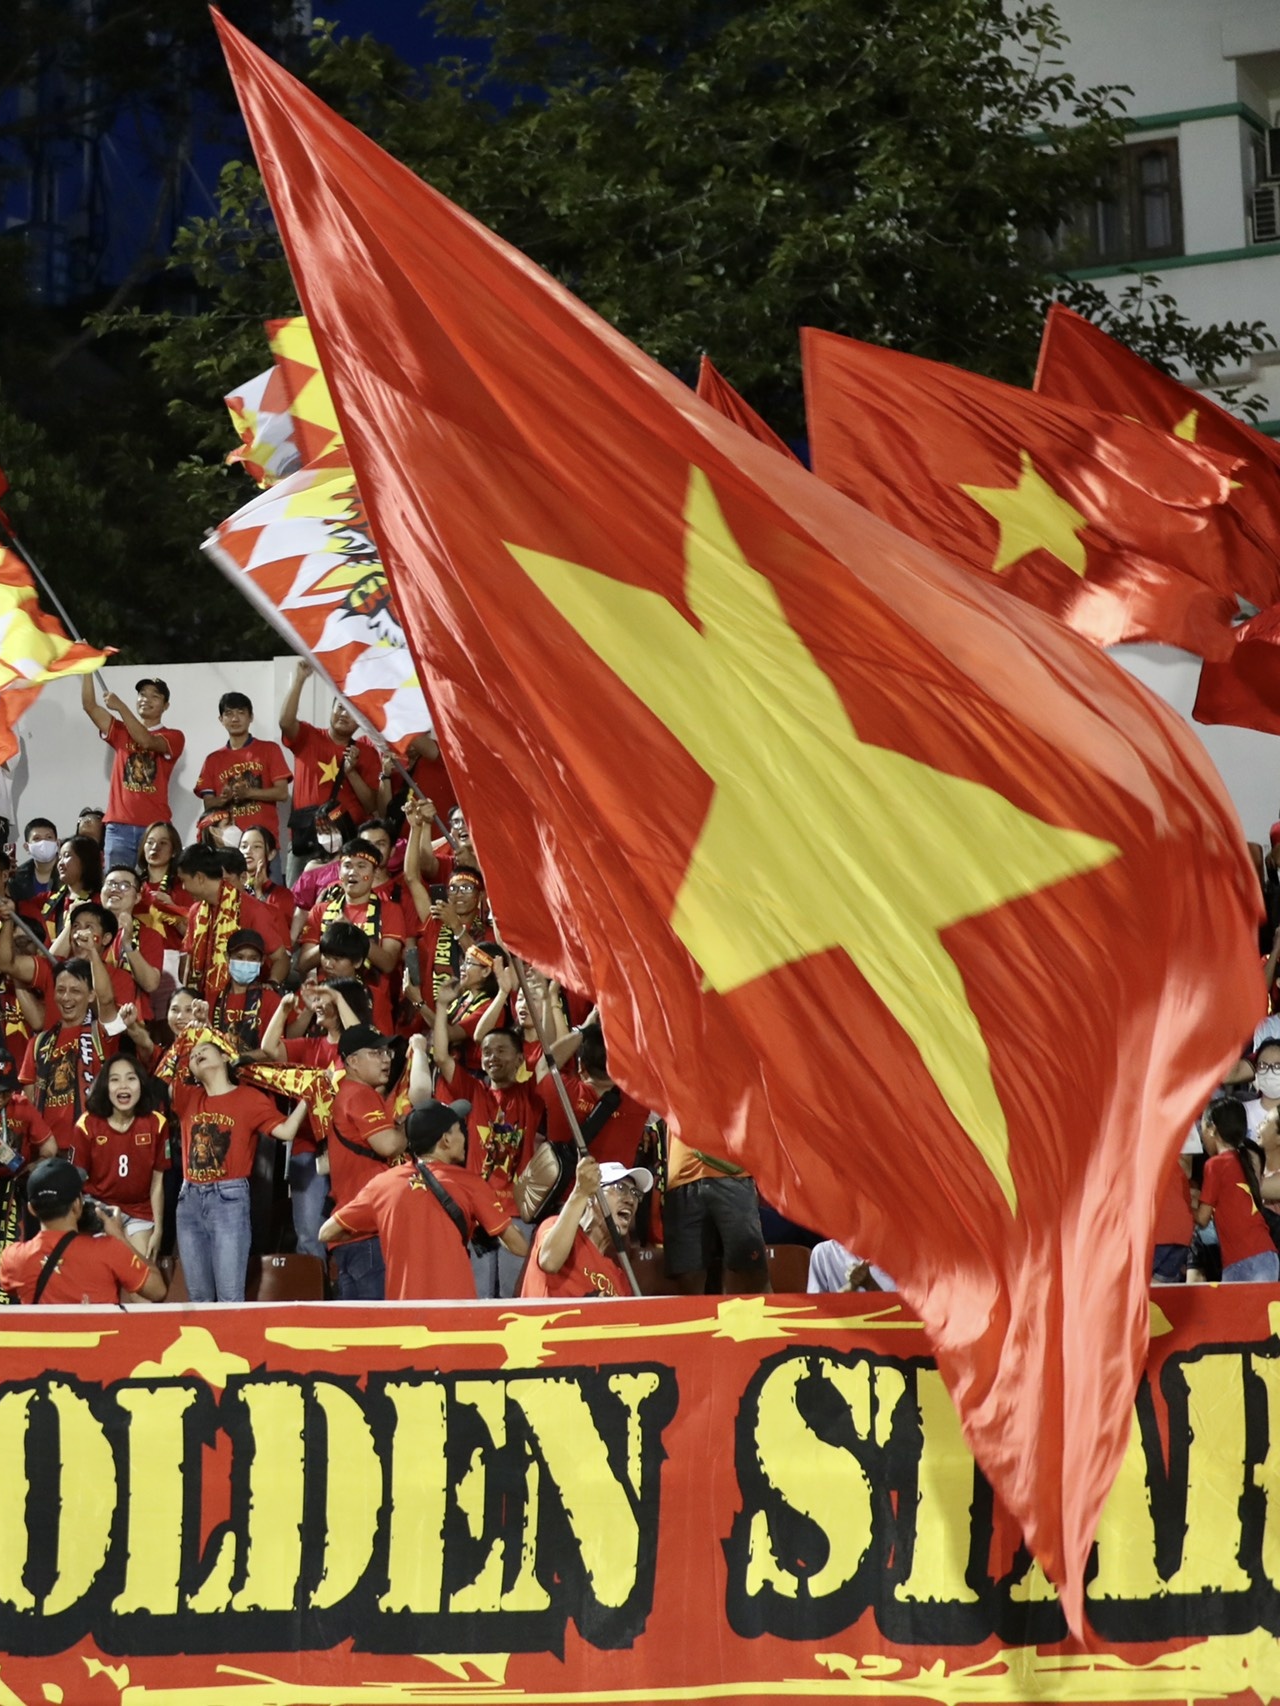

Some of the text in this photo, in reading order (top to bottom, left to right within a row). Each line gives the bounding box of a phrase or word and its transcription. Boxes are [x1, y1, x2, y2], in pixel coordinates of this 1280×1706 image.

[118, 1154, 129, 1177] 8
[639, 1250, 653, 1260] 70
[271, 1257, 287, 1267] 67
